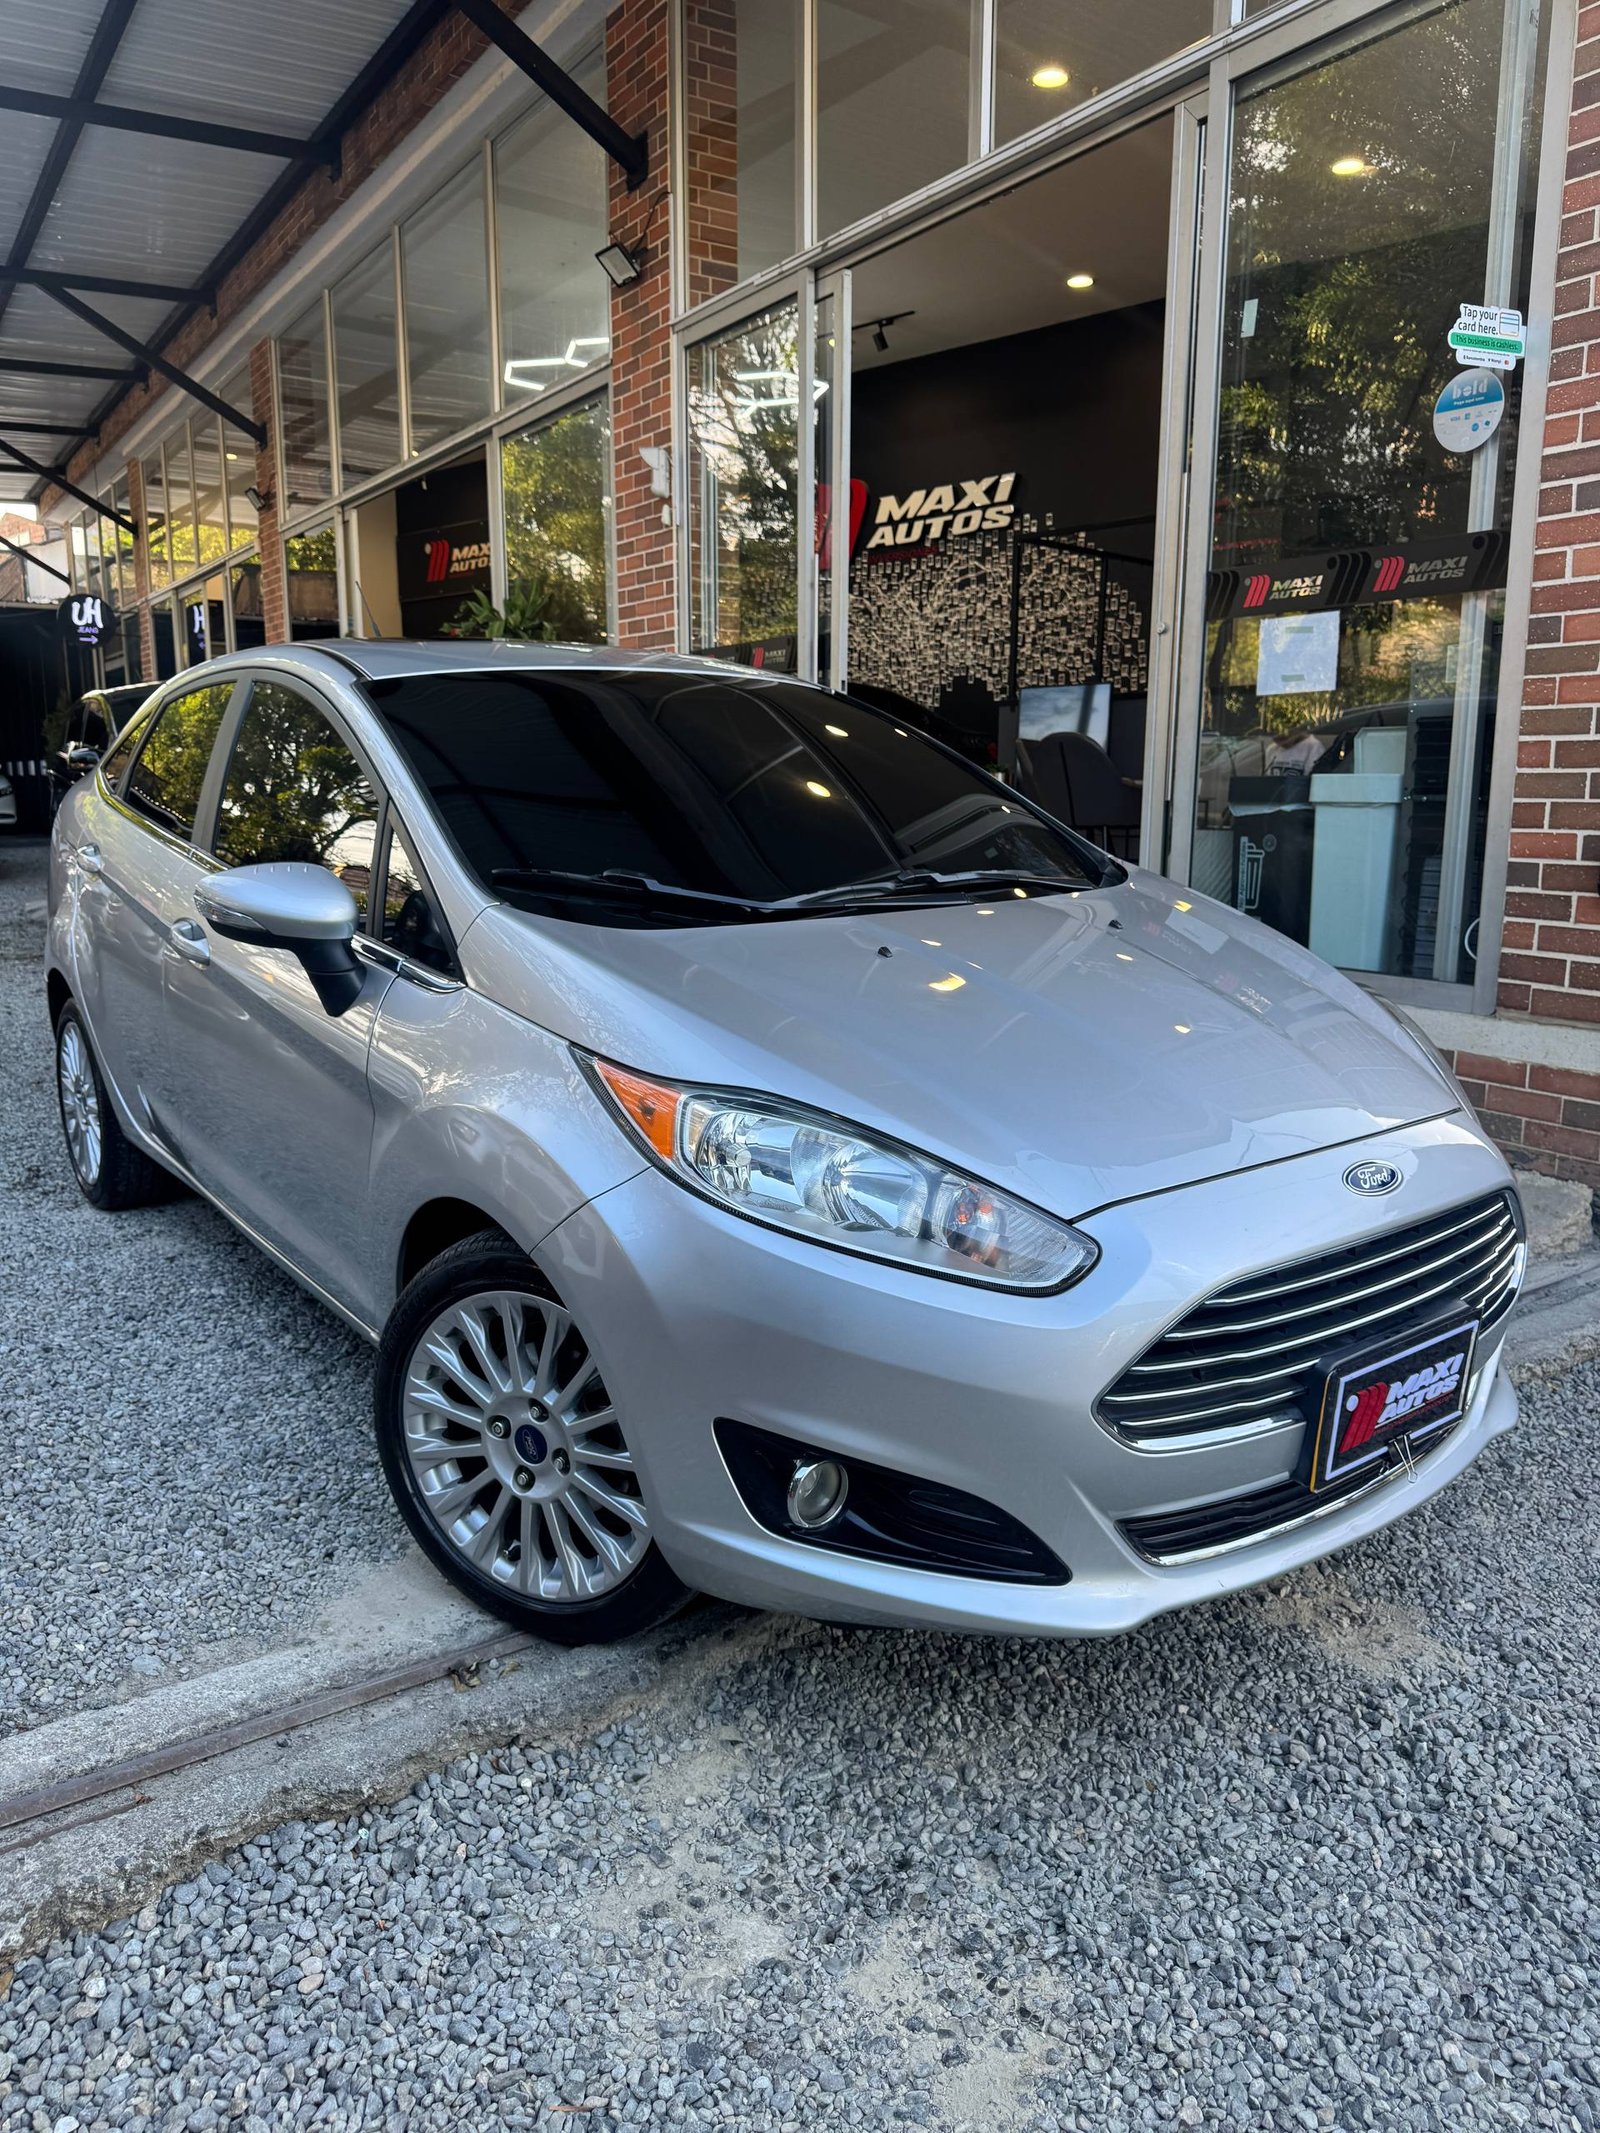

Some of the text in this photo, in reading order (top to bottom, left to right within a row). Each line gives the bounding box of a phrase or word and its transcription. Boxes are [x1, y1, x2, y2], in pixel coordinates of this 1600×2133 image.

[1463, 306, 1498, 321] Tap your
[1458, 321, 1499, 335] card here.
[1456, 335, 1467, 344] This
[1468, 336, 1490, 347] business
[1453, 379, 1488, 399] bold
[875, 472, 1016, 525] MAXI
[866, 504, 1015, 549] AUTOS
[452, 542, 491, 561] MAX
[449, 556, 492, 574] AUTO
[1407, 555, 1468, 574] MAXI
[1272, 574, 1323, 592] MAXI
[1402, 567, 1465, 585] AUTOS
[1269, 586, 1322, 600] AUTOS
[1357, 1166, 1391, 1189] Ford
[1385, 1352, 1465, 1404] MAXI
[1377, 1373, 1460, 1424] AUTOS
